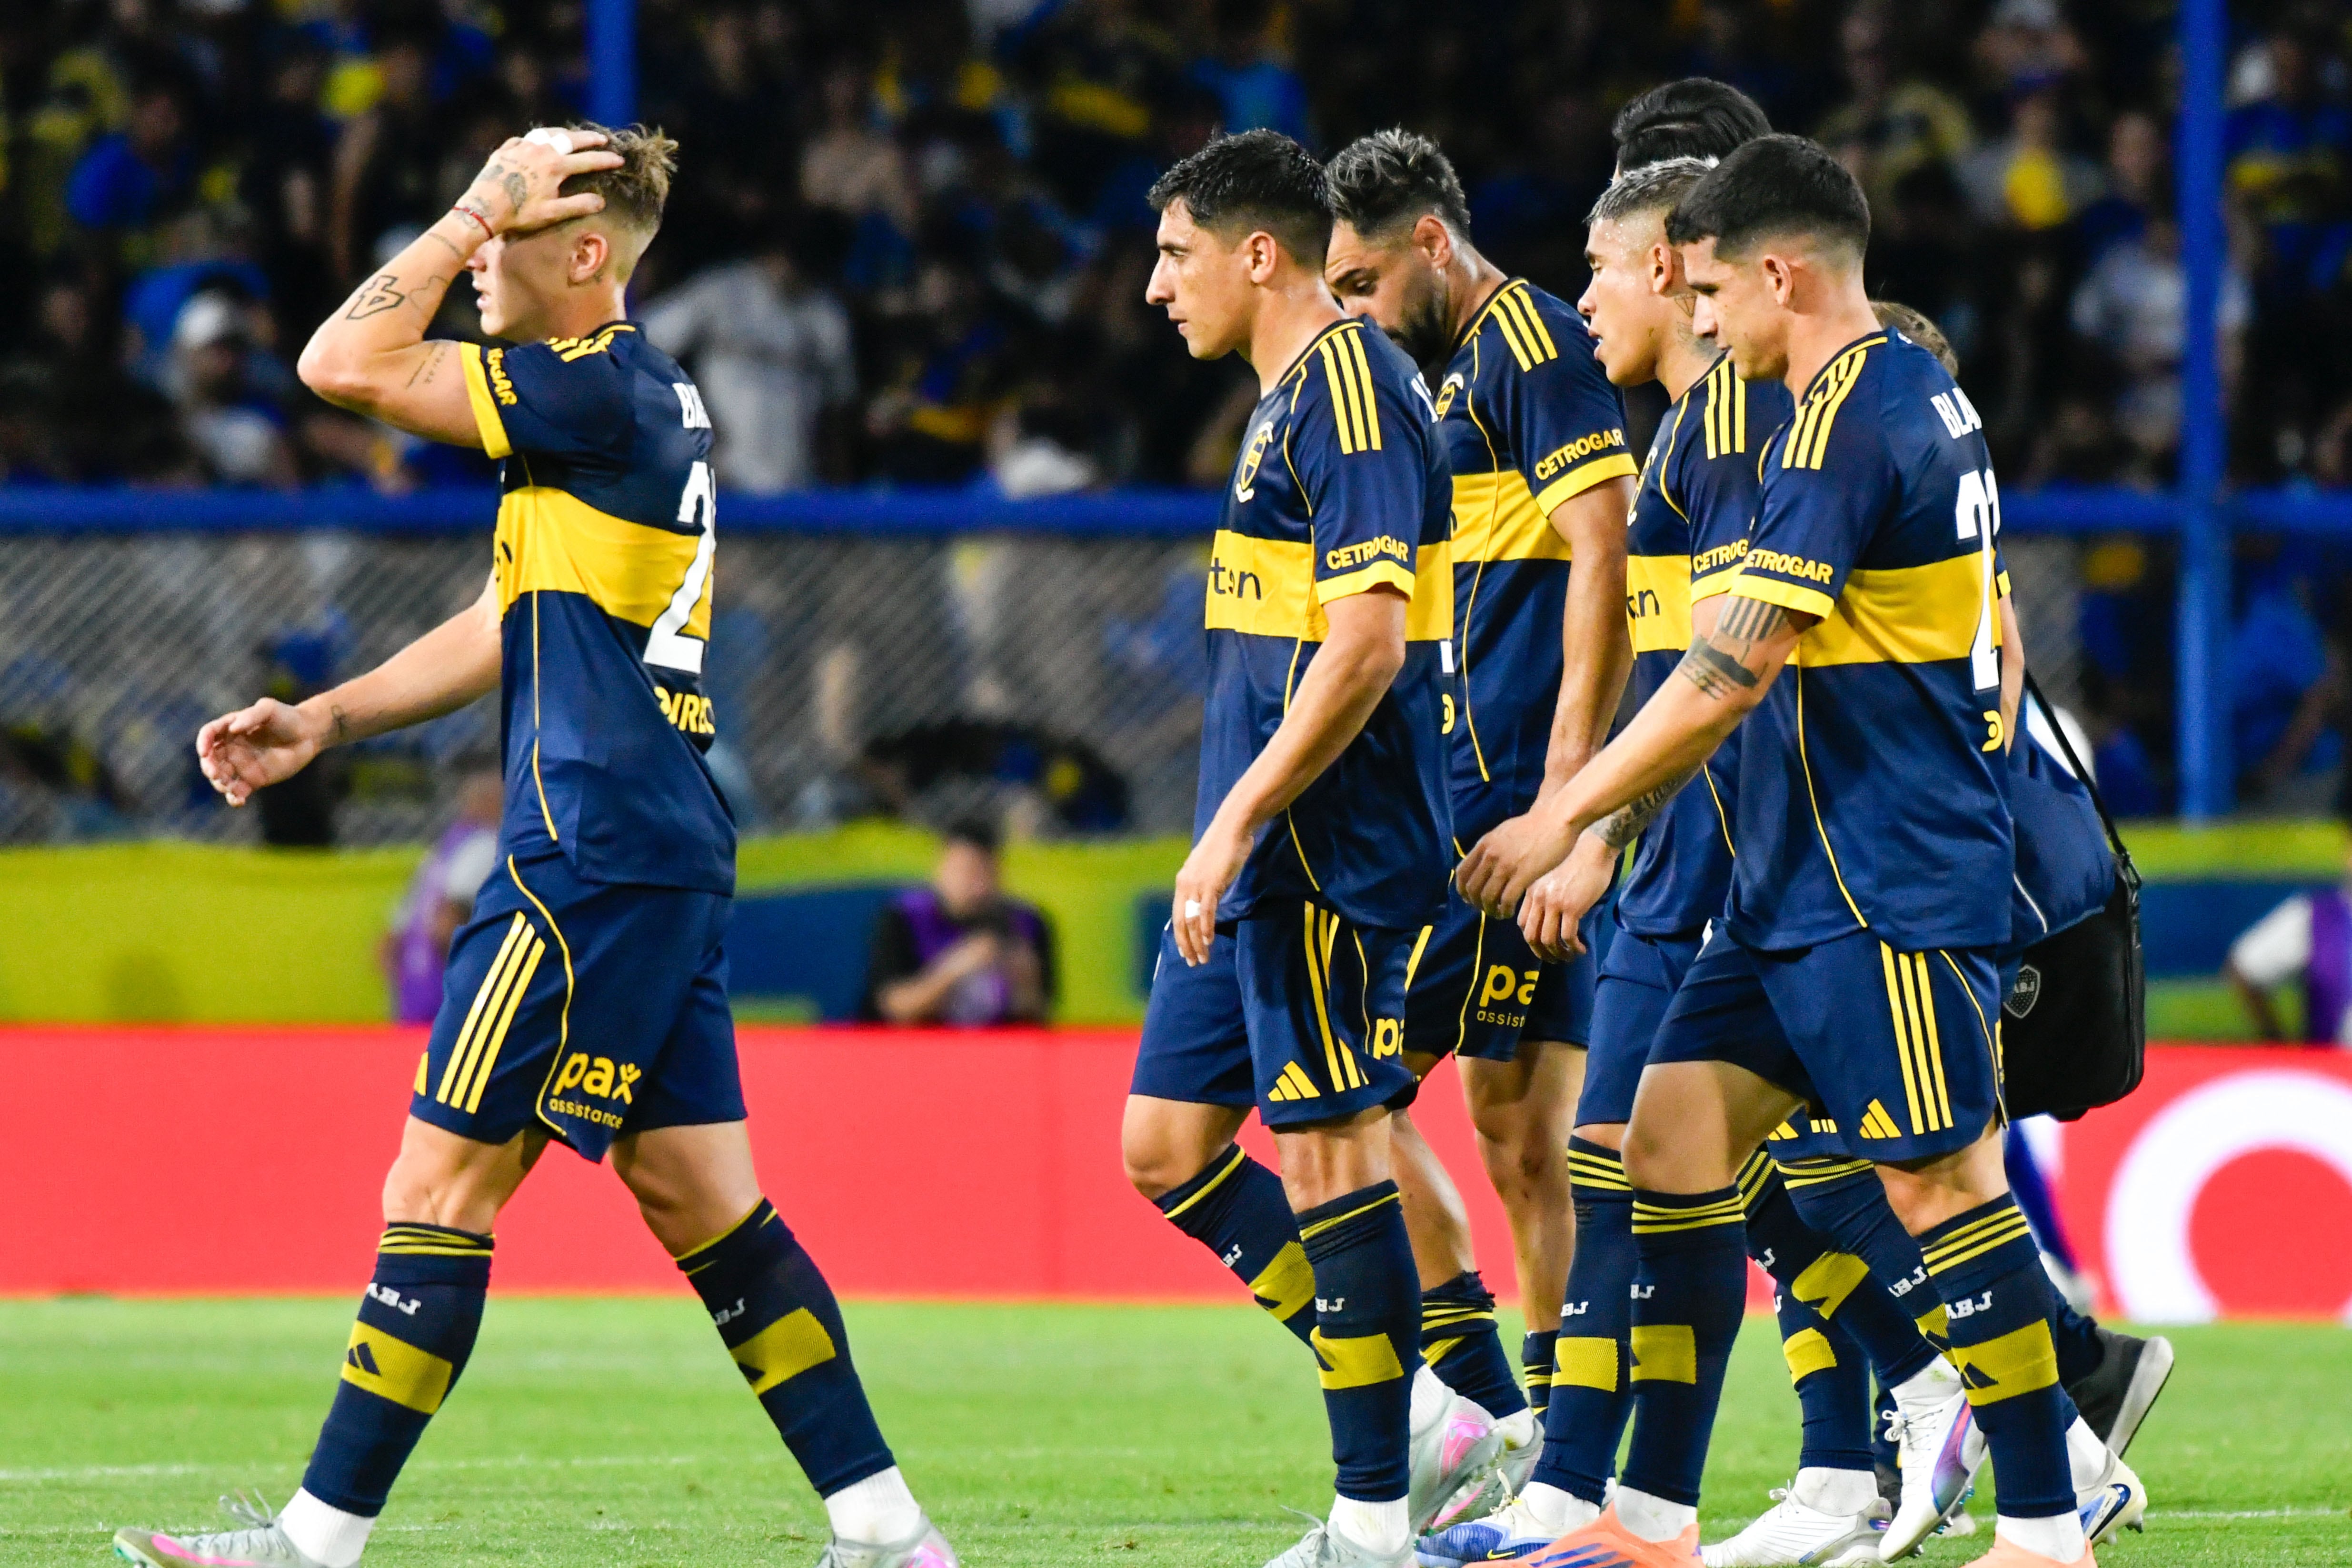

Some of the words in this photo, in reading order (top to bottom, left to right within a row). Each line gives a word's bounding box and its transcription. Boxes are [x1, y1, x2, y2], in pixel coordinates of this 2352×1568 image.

[1535, 429, 1624, 480] CETROGAR
[643, 461, 717, 674] 2
[1326, 535, 1409, 570] CETROGAR
[1693, 539, 1749, 574] CETROG
[552, 1052, 641, 1105] pax
[549, 1098, 624, 1129] assstance
